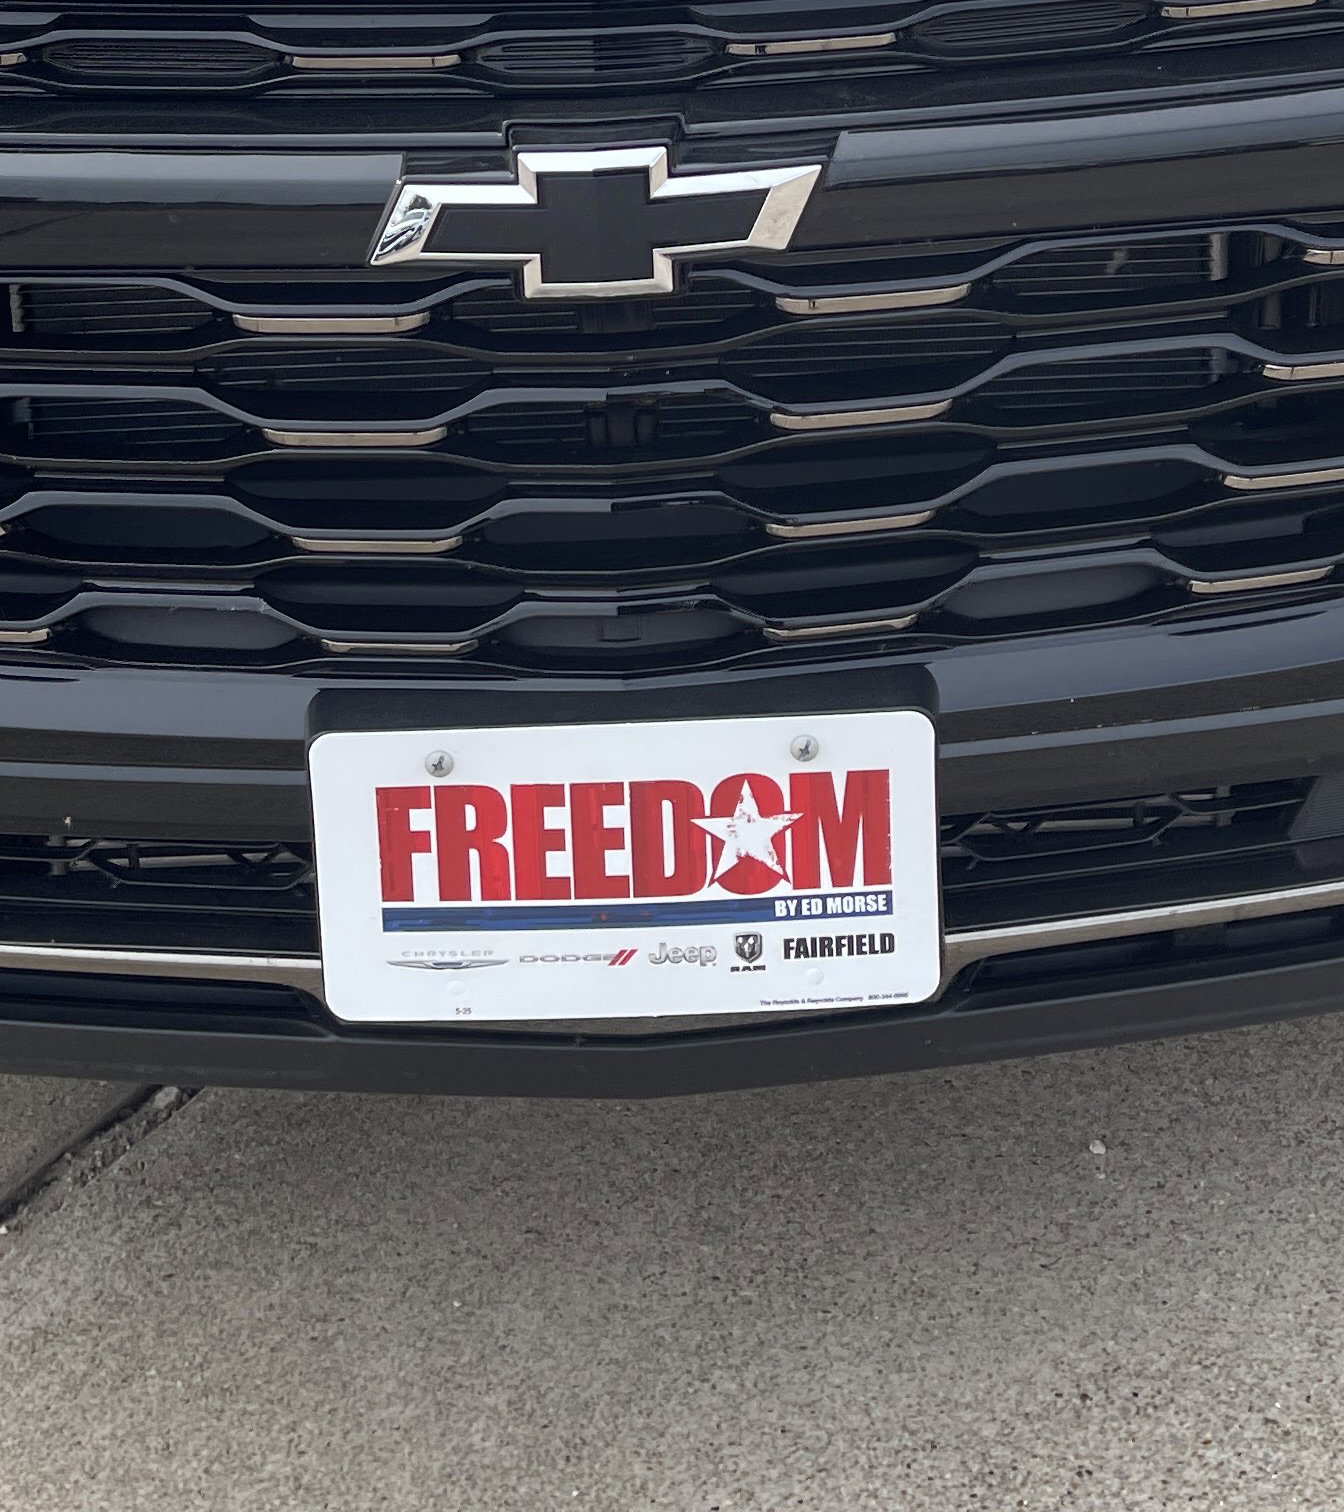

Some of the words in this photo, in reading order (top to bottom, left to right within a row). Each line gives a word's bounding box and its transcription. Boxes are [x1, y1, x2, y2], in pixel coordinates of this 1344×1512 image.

[375, 769, 893, 902] FREEDOM
[774, 899, 798, 918] BY
[801, 897, 823, 916] ED
[826, 894, 888, 915] MORSE
[401, 949, 494, 958] CHRYSLER
[649, 942, 718, 967] Jeep
[783, 933, 895, 959] FAIRFIELD
[519, 953, 616, 964] DODGE
